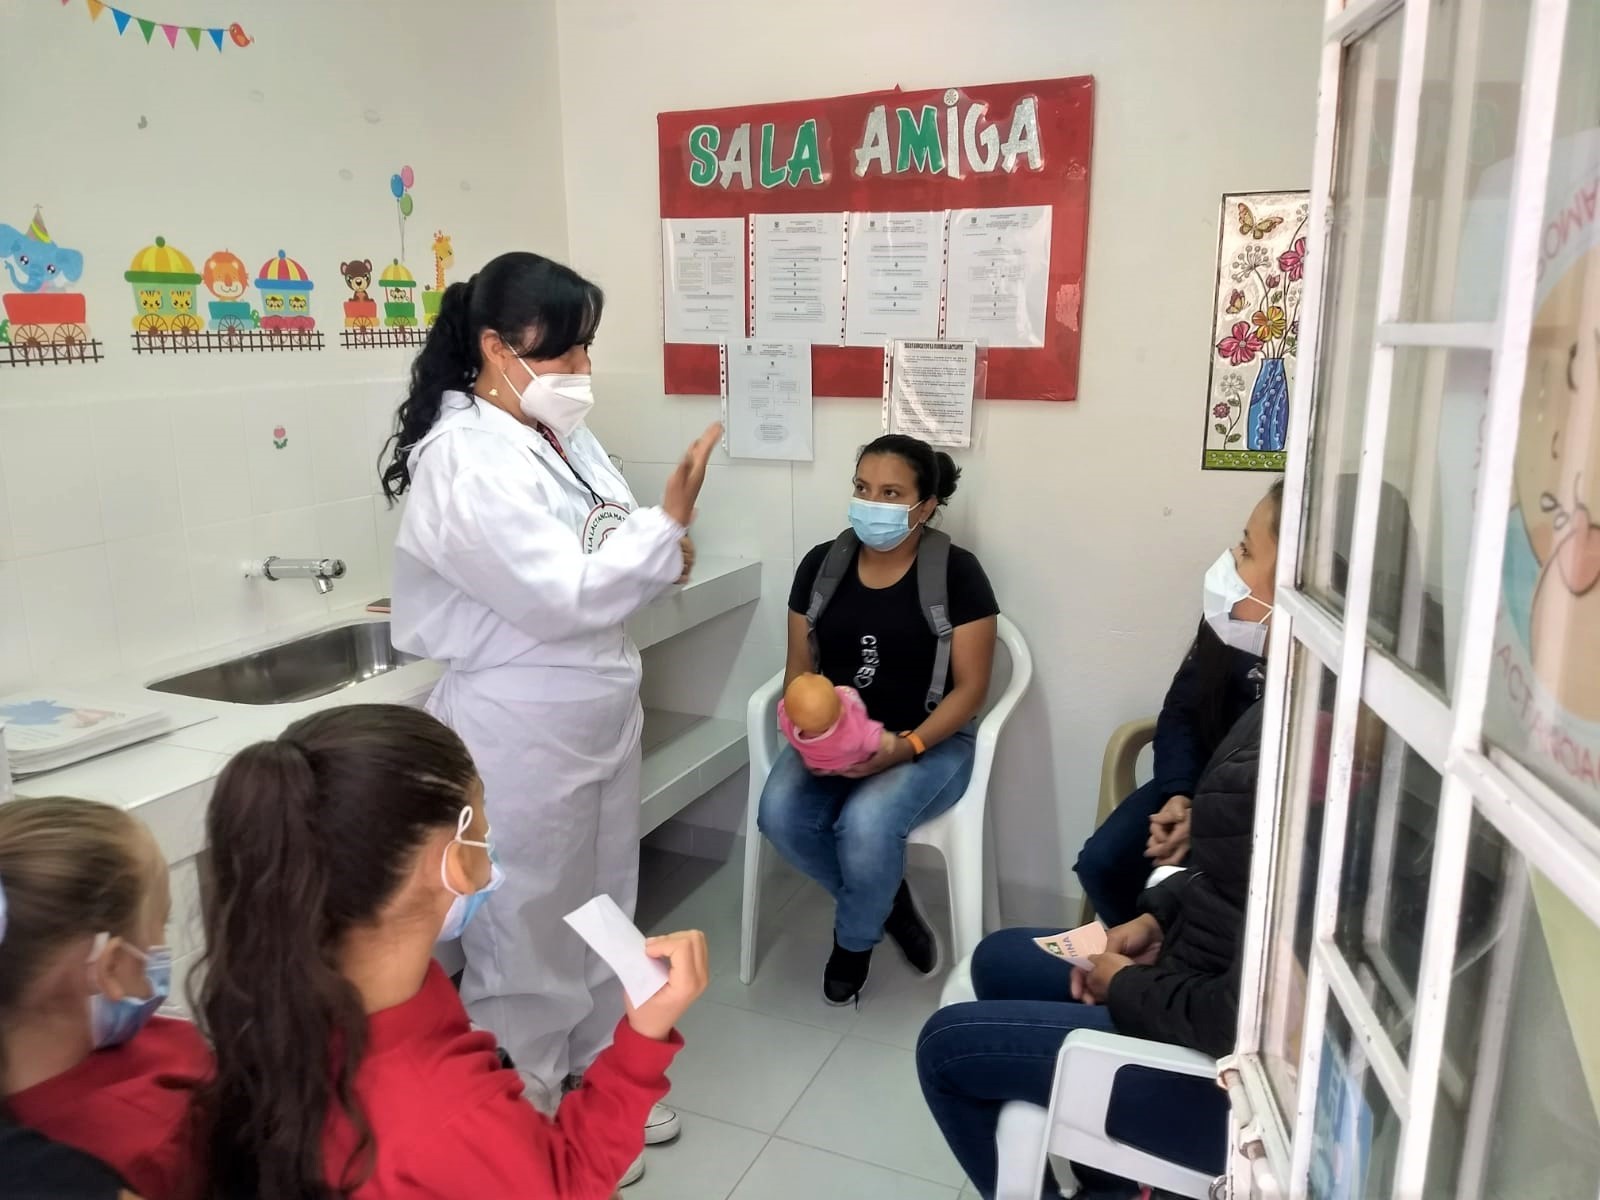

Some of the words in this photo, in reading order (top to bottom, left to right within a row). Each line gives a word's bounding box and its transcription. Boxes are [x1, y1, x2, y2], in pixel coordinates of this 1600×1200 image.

[689, 118, 824, 190] SALA
[855, 89, 1043, 178] AMIGA
[589, 511, 613, 536] LACTANCIA
